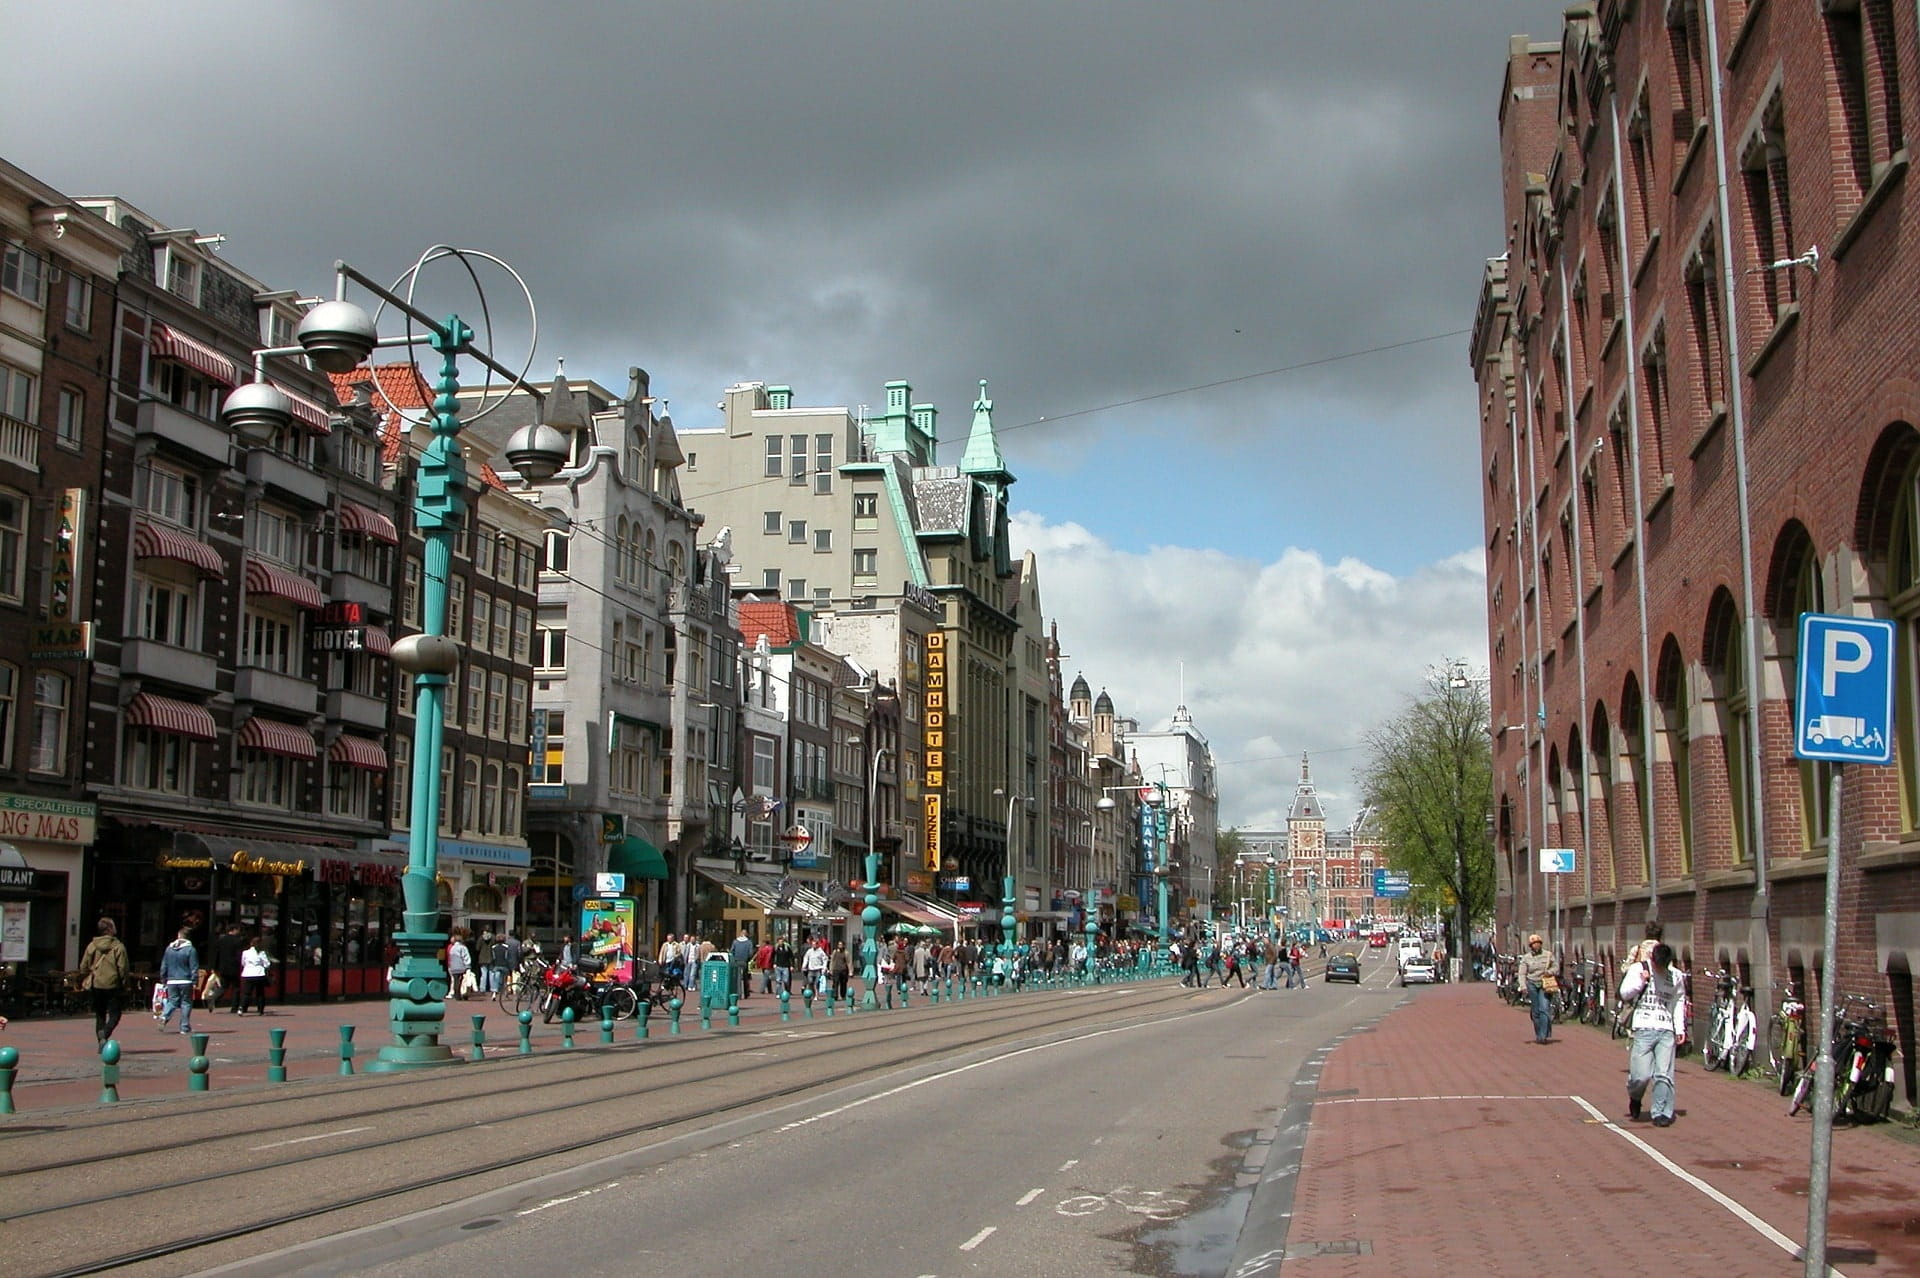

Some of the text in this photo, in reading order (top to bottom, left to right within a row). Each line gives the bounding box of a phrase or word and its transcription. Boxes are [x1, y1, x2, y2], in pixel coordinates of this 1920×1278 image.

[54, 495, 72, 618] SARANG
[314, 602, 361, 623] DELTA
[37, 628, 81, 645] MAS
[313, 629, 362, 650] HOTEL
[1823, 629, 1872, 697] P
[532, 711, 545, 781] HOTEL
[14, 798, 94, 816] SPECIALITEITEN
[35, 814, 79, 840] MAS
[927, 797, 937, 868] PIZZERIA
[459, 846, 511, 860] CONTINENTAL
[0, 871, 34, 885] URANT
